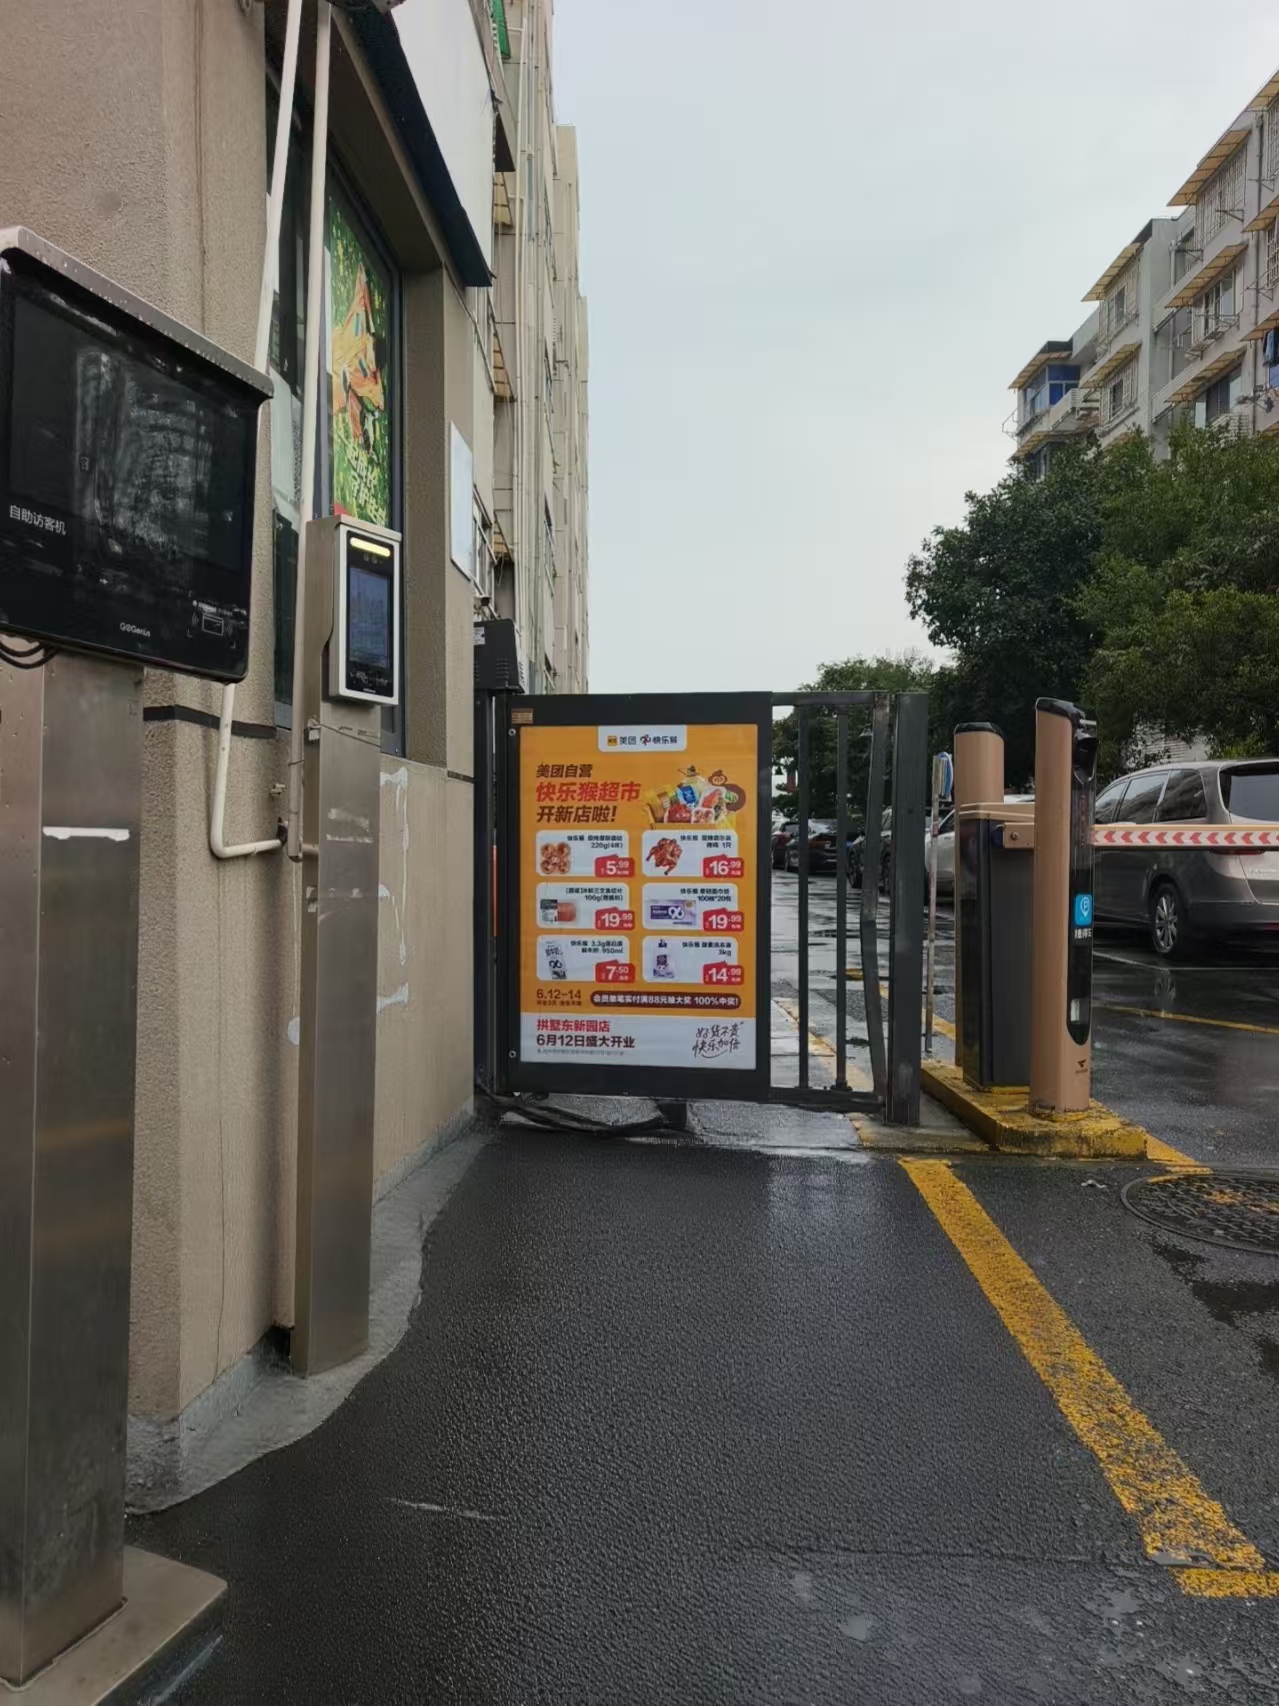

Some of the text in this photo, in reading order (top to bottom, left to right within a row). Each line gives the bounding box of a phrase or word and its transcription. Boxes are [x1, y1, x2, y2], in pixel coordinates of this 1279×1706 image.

[10, 505, 66, 535] 自助访客机
[619, 736, 637, 745] 美团
[652, 736, 678, 744] 快乐猴
[536, 764, 593, 778] 美团自营
[536, 781, 641, 802] 快乐猴超市
[536, 805, 617, 823] 开新店啦!
[718, 949, 731, 957] 3kg
[536, 989, 582, 999] 6.12-14
[537, 1019, 611, 1033] 拱墅东新园店
[536, 1034, 635, 1048] 6月12日盛大开业
